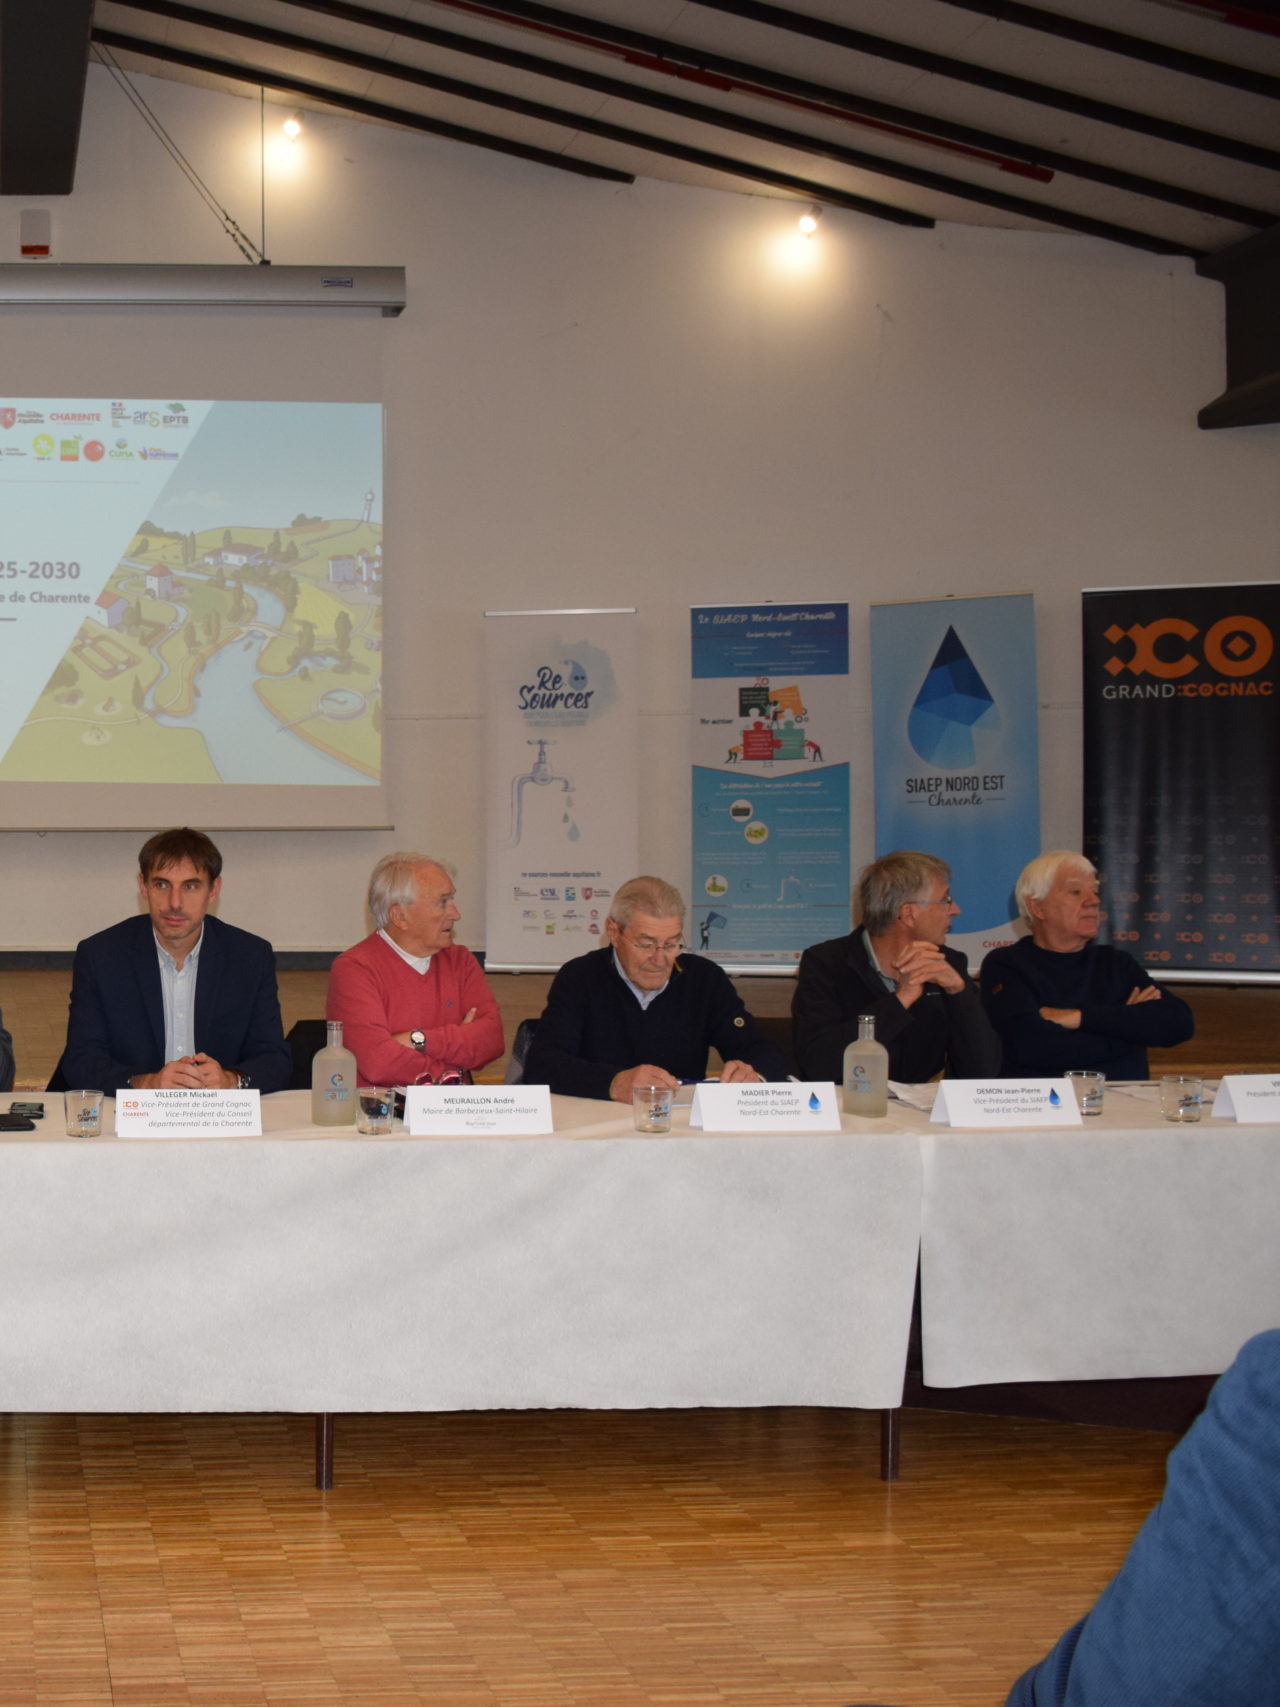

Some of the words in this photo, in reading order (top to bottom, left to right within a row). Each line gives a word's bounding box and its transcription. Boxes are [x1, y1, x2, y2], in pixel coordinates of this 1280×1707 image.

[49, 412, 101, 422] CHARENTE
[163, 415, 189, 424] EPTB
[9, 591, 25, 603] de
[30, 591, 91, 604] Charente
[536, 666, 564, 691] Re
[1102, 683, 1175, 700] GRAND
[518, 685, 595, 710] Sources
[906, 777, 942, 794] SIAEP
[946, 776, 979, 792] NORD
[983, 775, 1006, 790] EST
[928, 792, 983, 807] Charente
[189, 1090, 218, 1098] Mickaël
[741, 1089, 770, 1097] MADIER
[772, 1088, 792, 1096] Pierre
[976, 1087, 1003, 1095] DEMON
[1005, 1086, 1041, 1095] Jean-Pierre
[443, 1097, 492, 1105] MEURAILLON
[493, 1096, 515, 1105] André
[737, 1098, 769, 1106] Président
[770, 1098, 779, 1106] du
[780, 1098, 800, 1106] SIAEP
[973, 1096, 1019, 1105] Vice-Président
[1020, 1096, 1029, 1104] du
[141, 1101, 191, 1109] Vice-Président
[202, 1101, 224, 1109] Grand
[226, 1102, 252, 1111] Cognac
[422, 1107, 443, 1115] Maire
[444, 1107, 454, 1115] de
[456, 1106, 538, 1115] Barbezieux-Saint-Hilaire
[983, 1106, 1012, 1115] Nord-Est
[1013, 1106, 1043, 1114] Charente
[165, 1110, 214, 1118] Vice-Président
[216, 1110, 226, 1118] du
[227, 1110, 252, 1118] Conseil
[740, 1108, 769, 1116] Nord-Est
[770, 1108, 801, 1116] Charente
[148, 1120, 200, 1129] départemental
[202, 1120, 211, 1128] de
[212, 1120, 219, 1128] la
[220, 1120, 253, 1128] Charente
